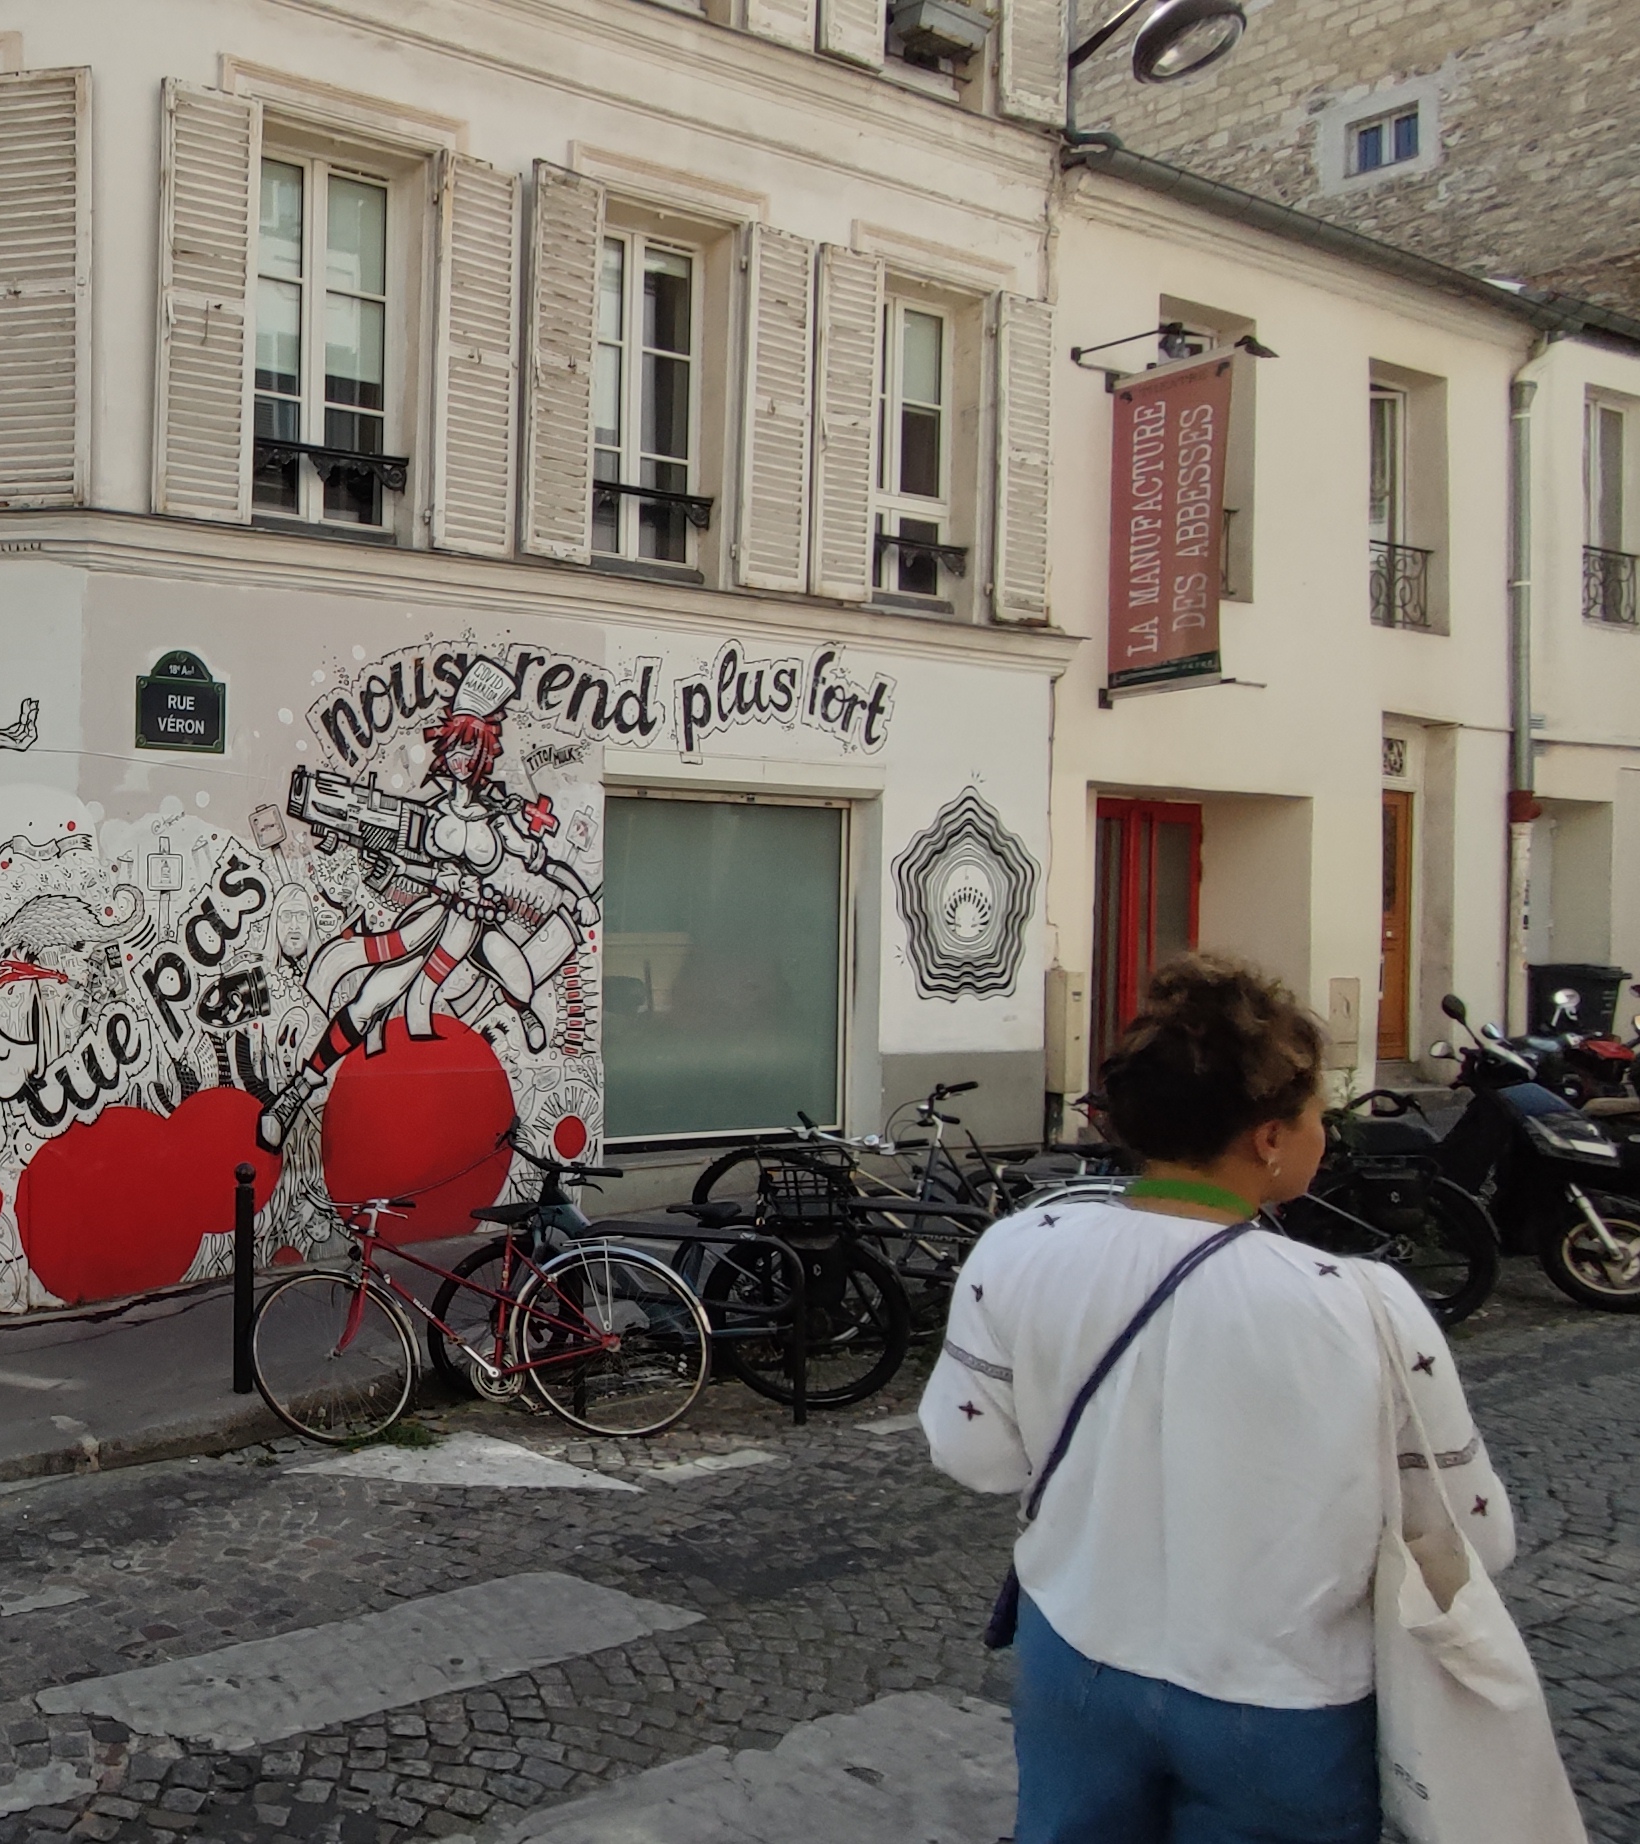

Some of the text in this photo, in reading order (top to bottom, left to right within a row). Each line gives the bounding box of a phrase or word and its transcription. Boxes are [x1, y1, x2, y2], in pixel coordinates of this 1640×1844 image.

[1126, 400, 1167, 658] LA MANUFACTURE
[1172, 404, 1214, 632] DES ABBESSES
[167, 694, 196, 711] RUE
[321, 649, 888, 767] nous rend plus fort
[473, 662, 505, 690] COVID
[157, 714, 205, 734] VÉRON
[18, 1013, 142, 1127] tue
[142, 854, 266, 1043] pas
[532, 1092, 567, 1138] NEVER
